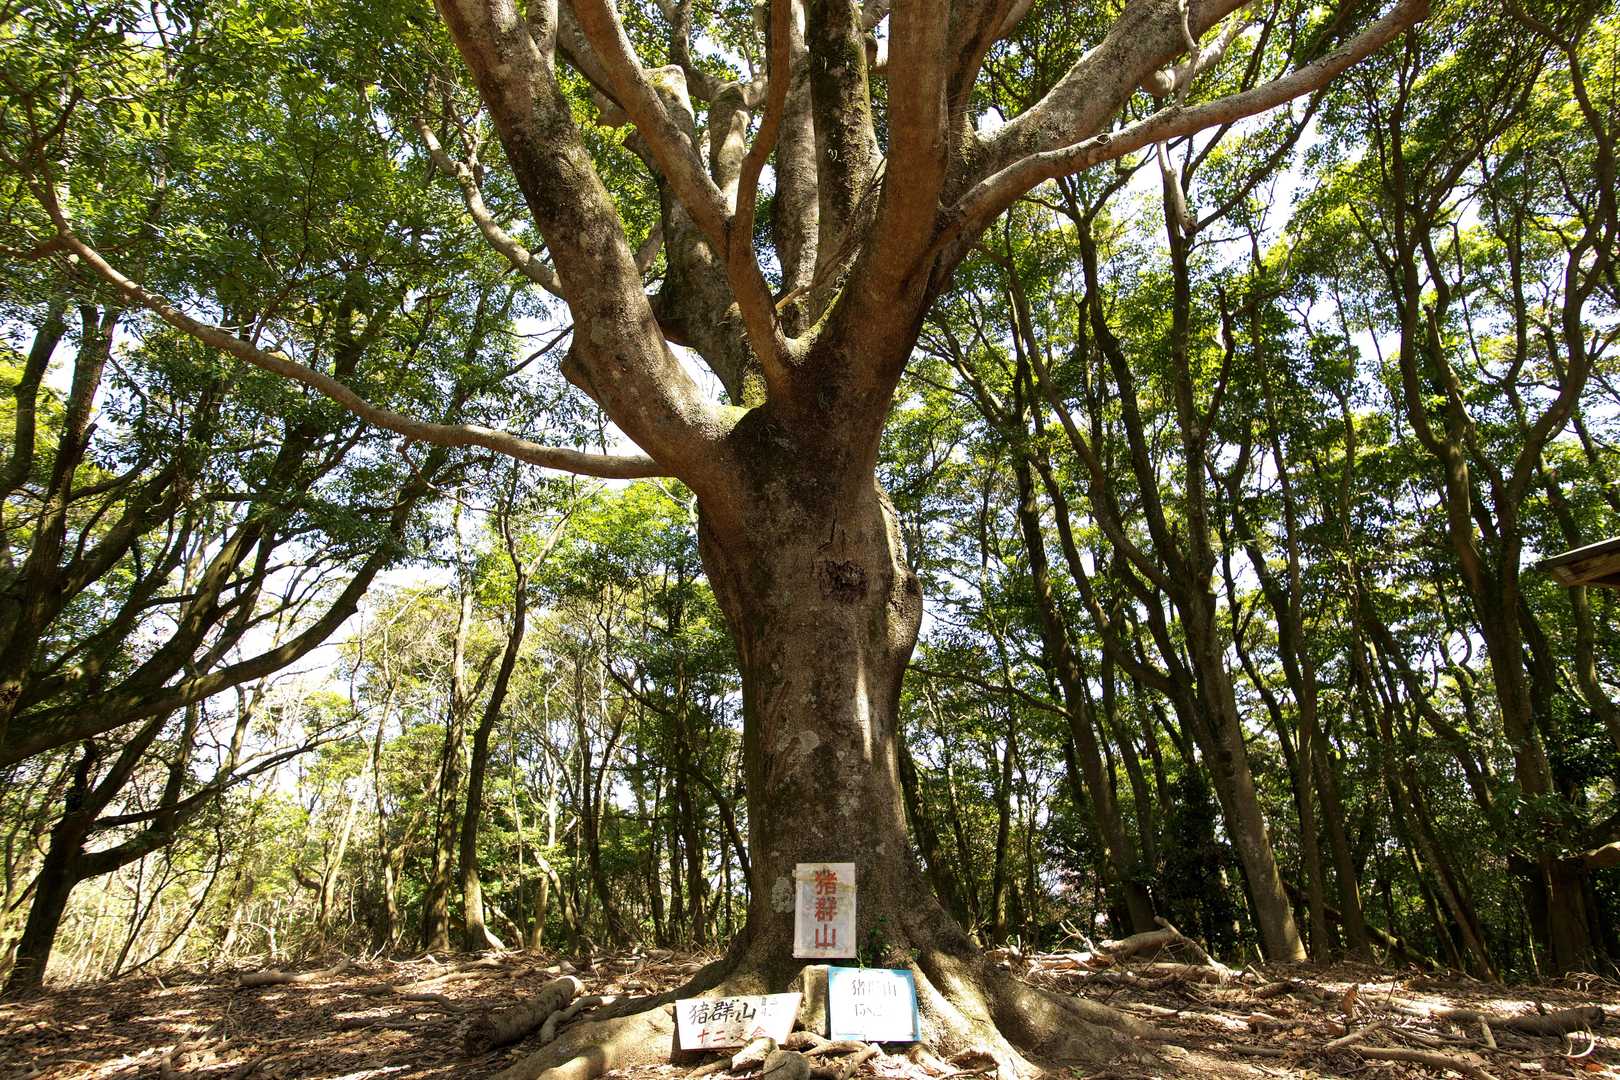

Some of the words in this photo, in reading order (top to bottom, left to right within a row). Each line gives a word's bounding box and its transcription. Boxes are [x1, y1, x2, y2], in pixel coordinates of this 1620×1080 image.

[815, 867, 838, 949] 猪群山
[852, 978, 897, 998] 猪山
[689, 998, 757, 1025] 猪群山
